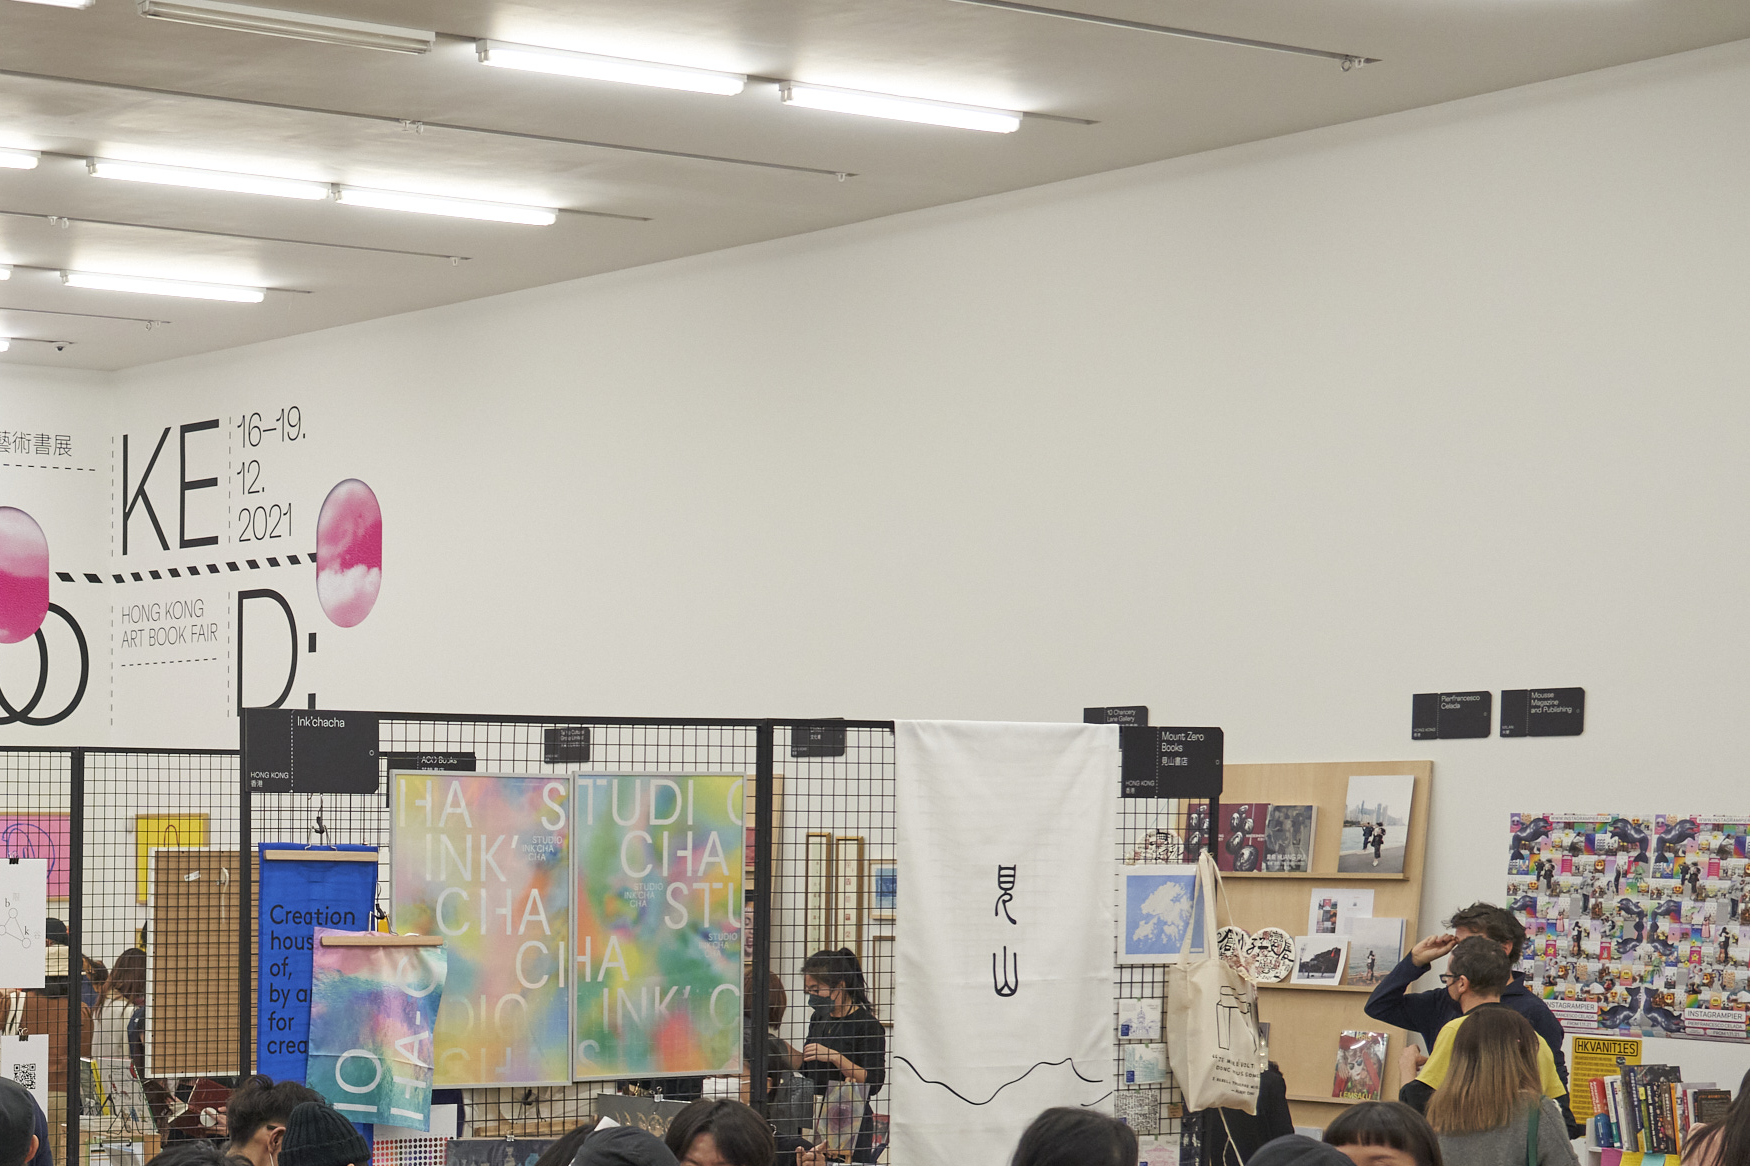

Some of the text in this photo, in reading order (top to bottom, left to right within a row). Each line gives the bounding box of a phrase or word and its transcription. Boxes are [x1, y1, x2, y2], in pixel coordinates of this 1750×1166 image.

[237, 460, 265, 495] 12.
[122, 418, 220, 556] KE
[238, 503, 292, 542] 2021
[122, 599, 204, 624] HONG KONG
[121, 622, 218, 648] ART BOOK FAIR
[1543, 706, 1573, 714] Publishing
[1161, 732, 1204, 741] Mount Zero
[1161, 743, 1183, 752] Books
[532, 836, 562, 844] STUDIO
[634, 883, 663, 891] STUDIO
[5, 898, 10, 907] b
[270, 904, 355, 926] Creation
[436, 887, 551, 936] CHA
[24, 926, 29, 935] k
[708, 932, 737, 941] STUDIO
[270, 931, 313, 950] hous
[270, 957, 292, 980] of,
[270, 983, 311, 1008] by a
[1547, 1002, 1594, 1010] NSTAGRAMPIER
[268, 1011, 294, 1031] for
[1687, 1011, 1743, 1020] INSTAGRAMPIER
[267, 1039, 308, 1054] crea
[1577, 1041, 1636, 1054] HKVANIT1ES
[1340, 1091, 1371, 1100] LEMSALU
